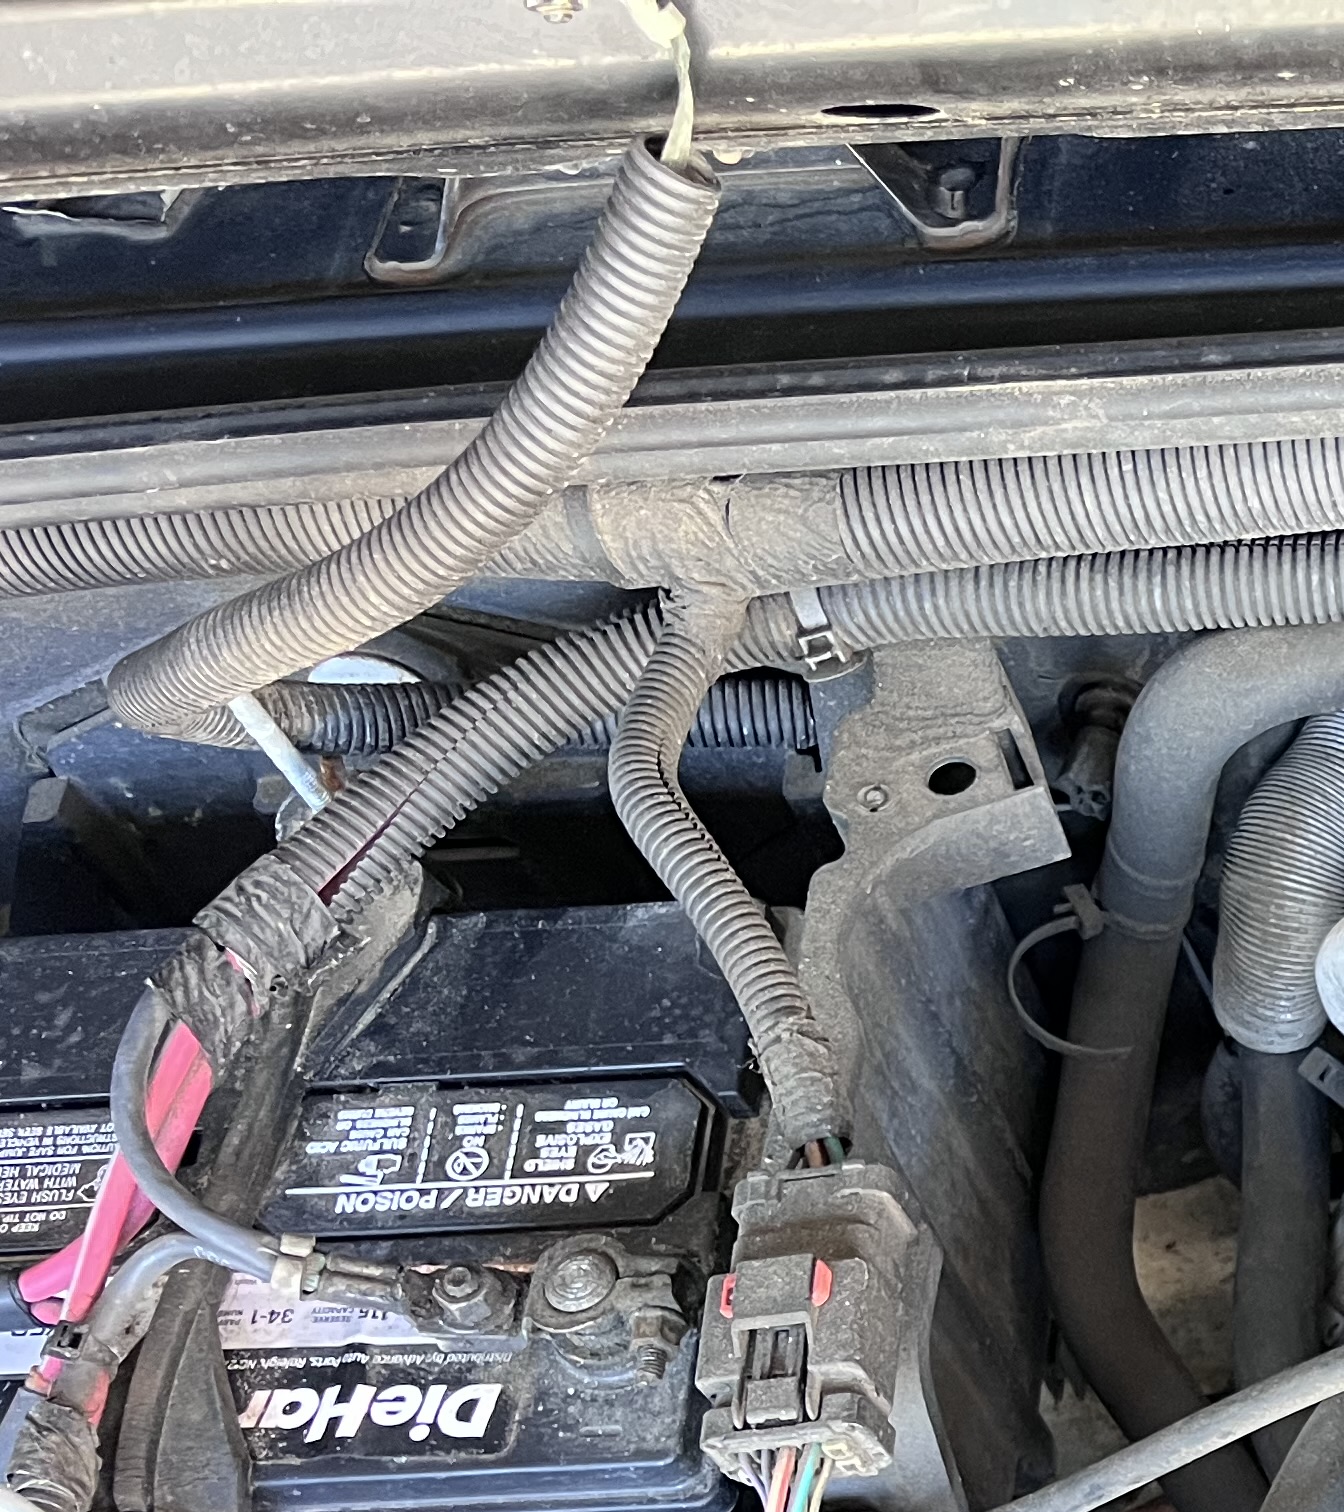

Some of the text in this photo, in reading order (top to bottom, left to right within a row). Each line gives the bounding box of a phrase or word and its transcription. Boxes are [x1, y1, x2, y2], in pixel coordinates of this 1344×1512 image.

[25, 1163, 81, 1177] MEDICAL
[44, 1176, 77, 1189] WITH
[31, 1189, 75, 1203] FLUSH
[335, 1190, 438, 1213] POISON
[465, 1183, 580, 1207] DANGER
[24, 1212, 47, 1222] NOT
[49, 1210, 67, 1221] DO
[11, 1222, 40, 1233] KEEP
[237, 1384, 502, 1443] DieHar
